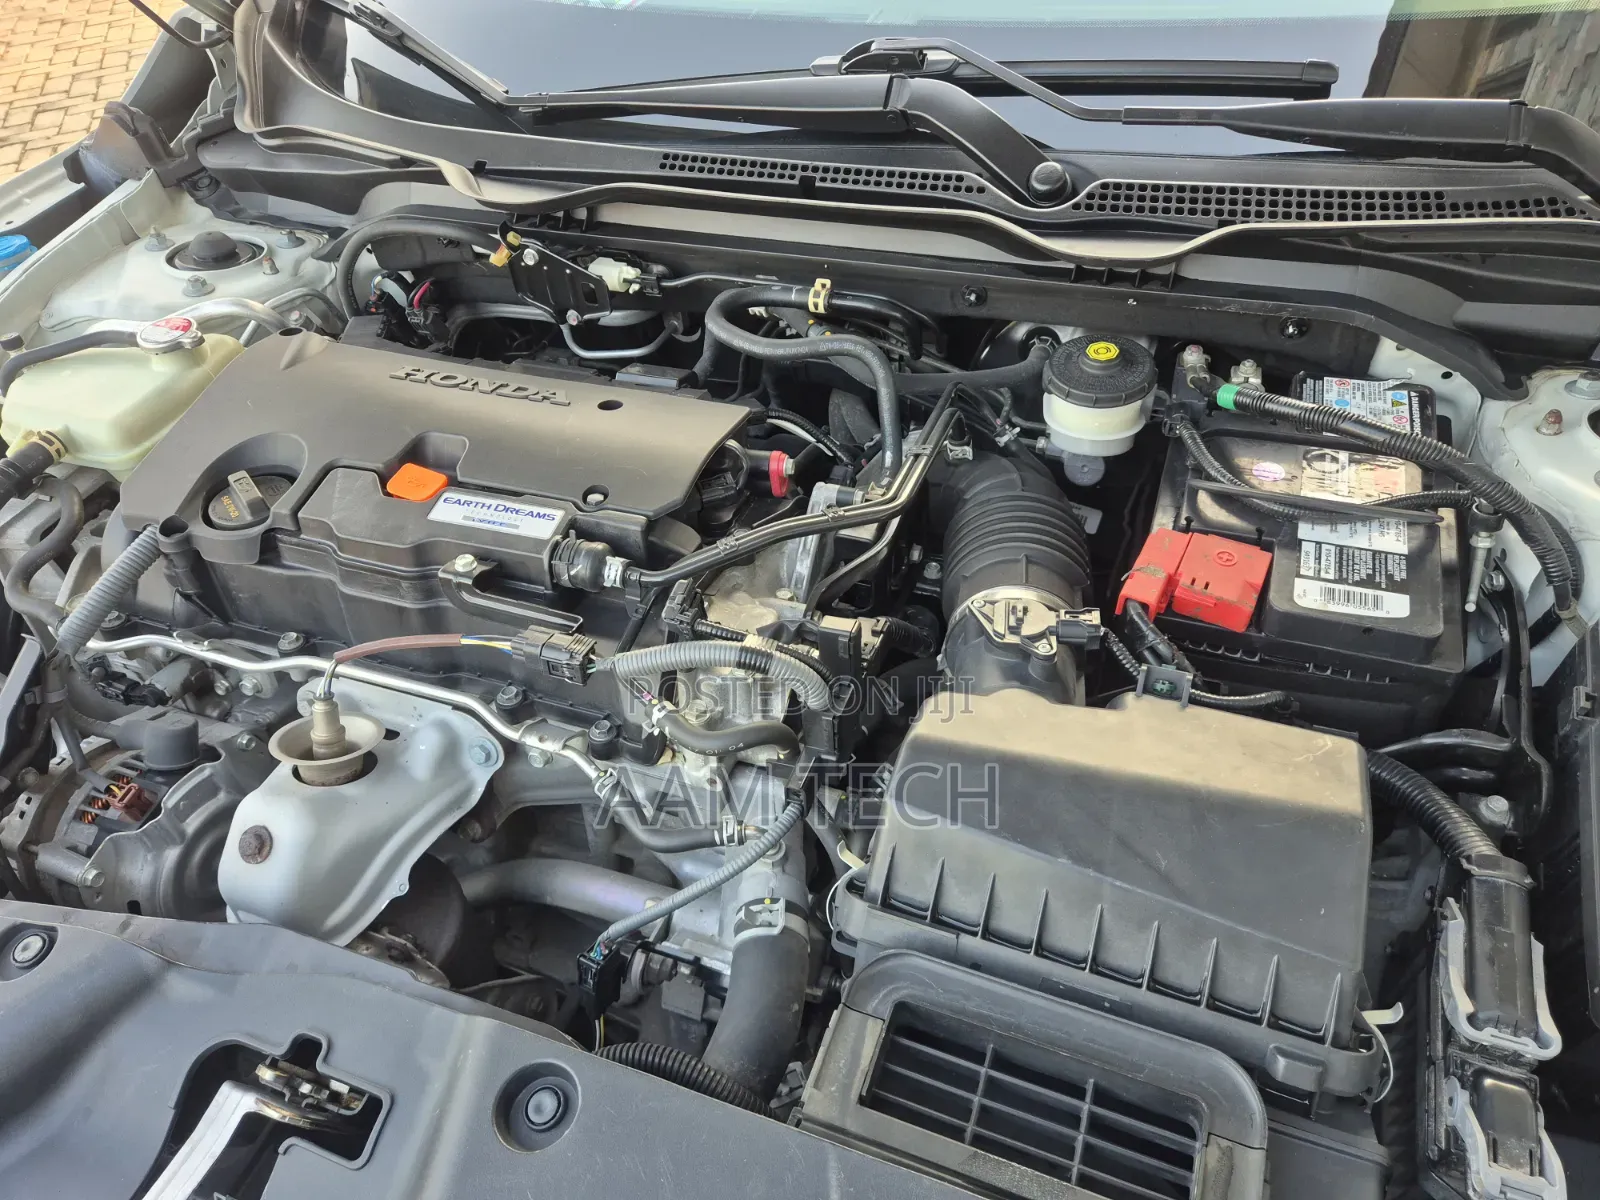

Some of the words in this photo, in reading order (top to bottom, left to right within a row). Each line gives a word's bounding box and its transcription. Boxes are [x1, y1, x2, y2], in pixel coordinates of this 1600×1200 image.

[389, 365, 571, 406] HONDA
[1411, 396, 1421, 435] DANGER/POISO
[443, 496, 492, 512] EARTH
[494, 503, 557, 521] DREAMS
